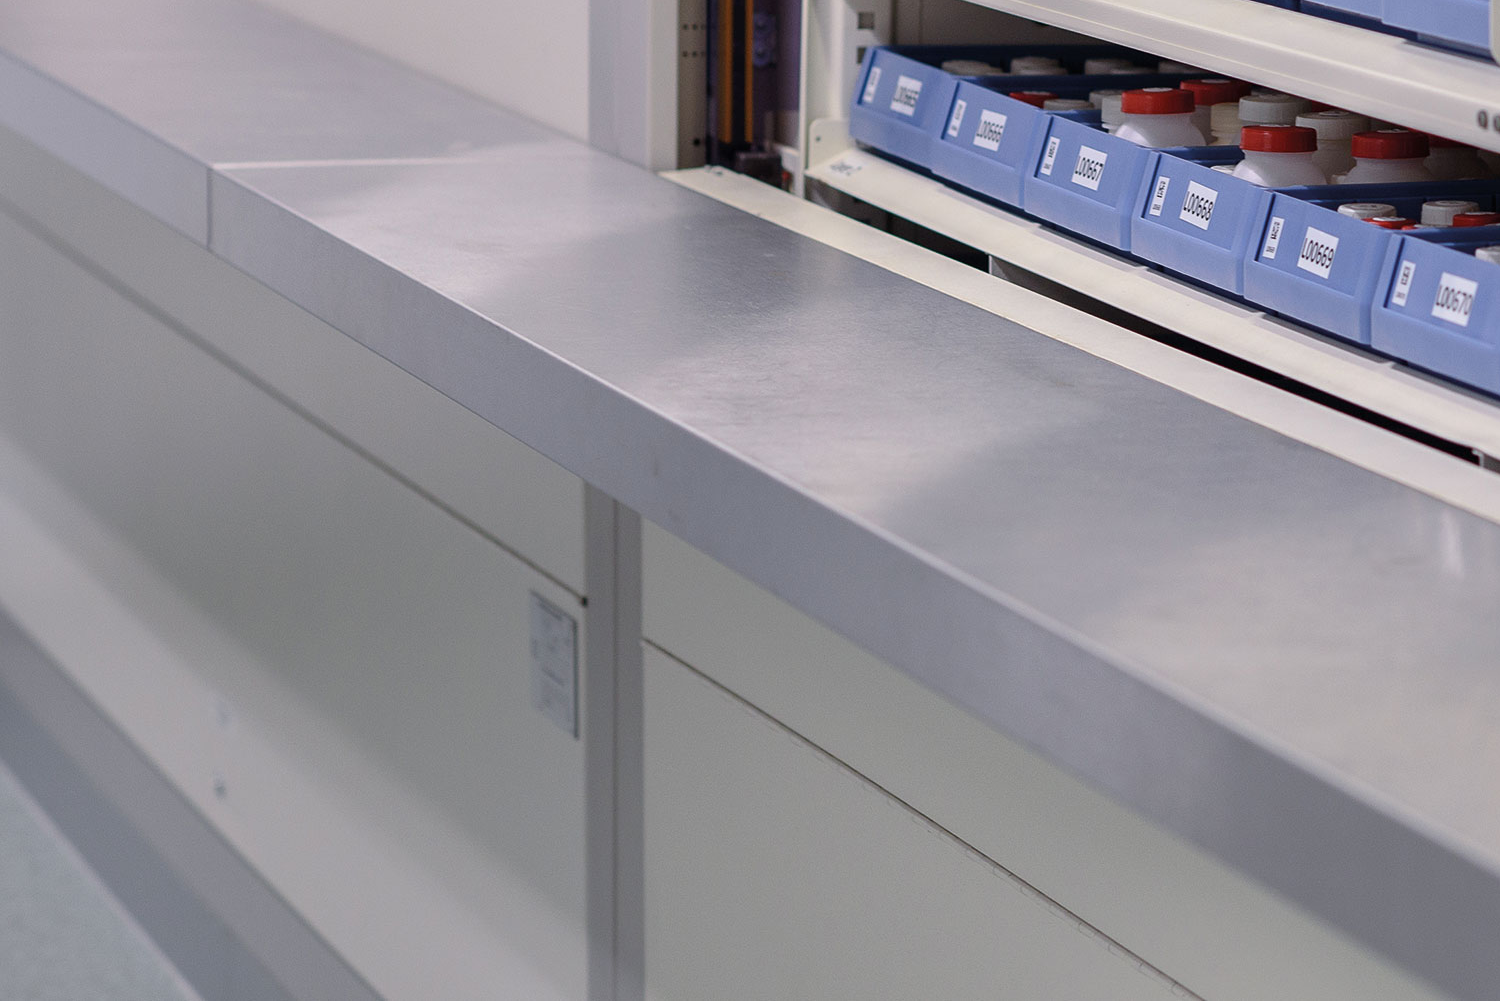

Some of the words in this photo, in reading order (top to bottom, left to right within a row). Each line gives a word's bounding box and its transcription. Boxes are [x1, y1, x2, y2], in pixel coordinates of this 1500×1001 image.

[1074, 156, 1104, 181] L00667
[1183, 192, 1214, 221] L00668
[1301, 238, 1335, 268] L00669
[1435, 284, 1472, 315] L00670
